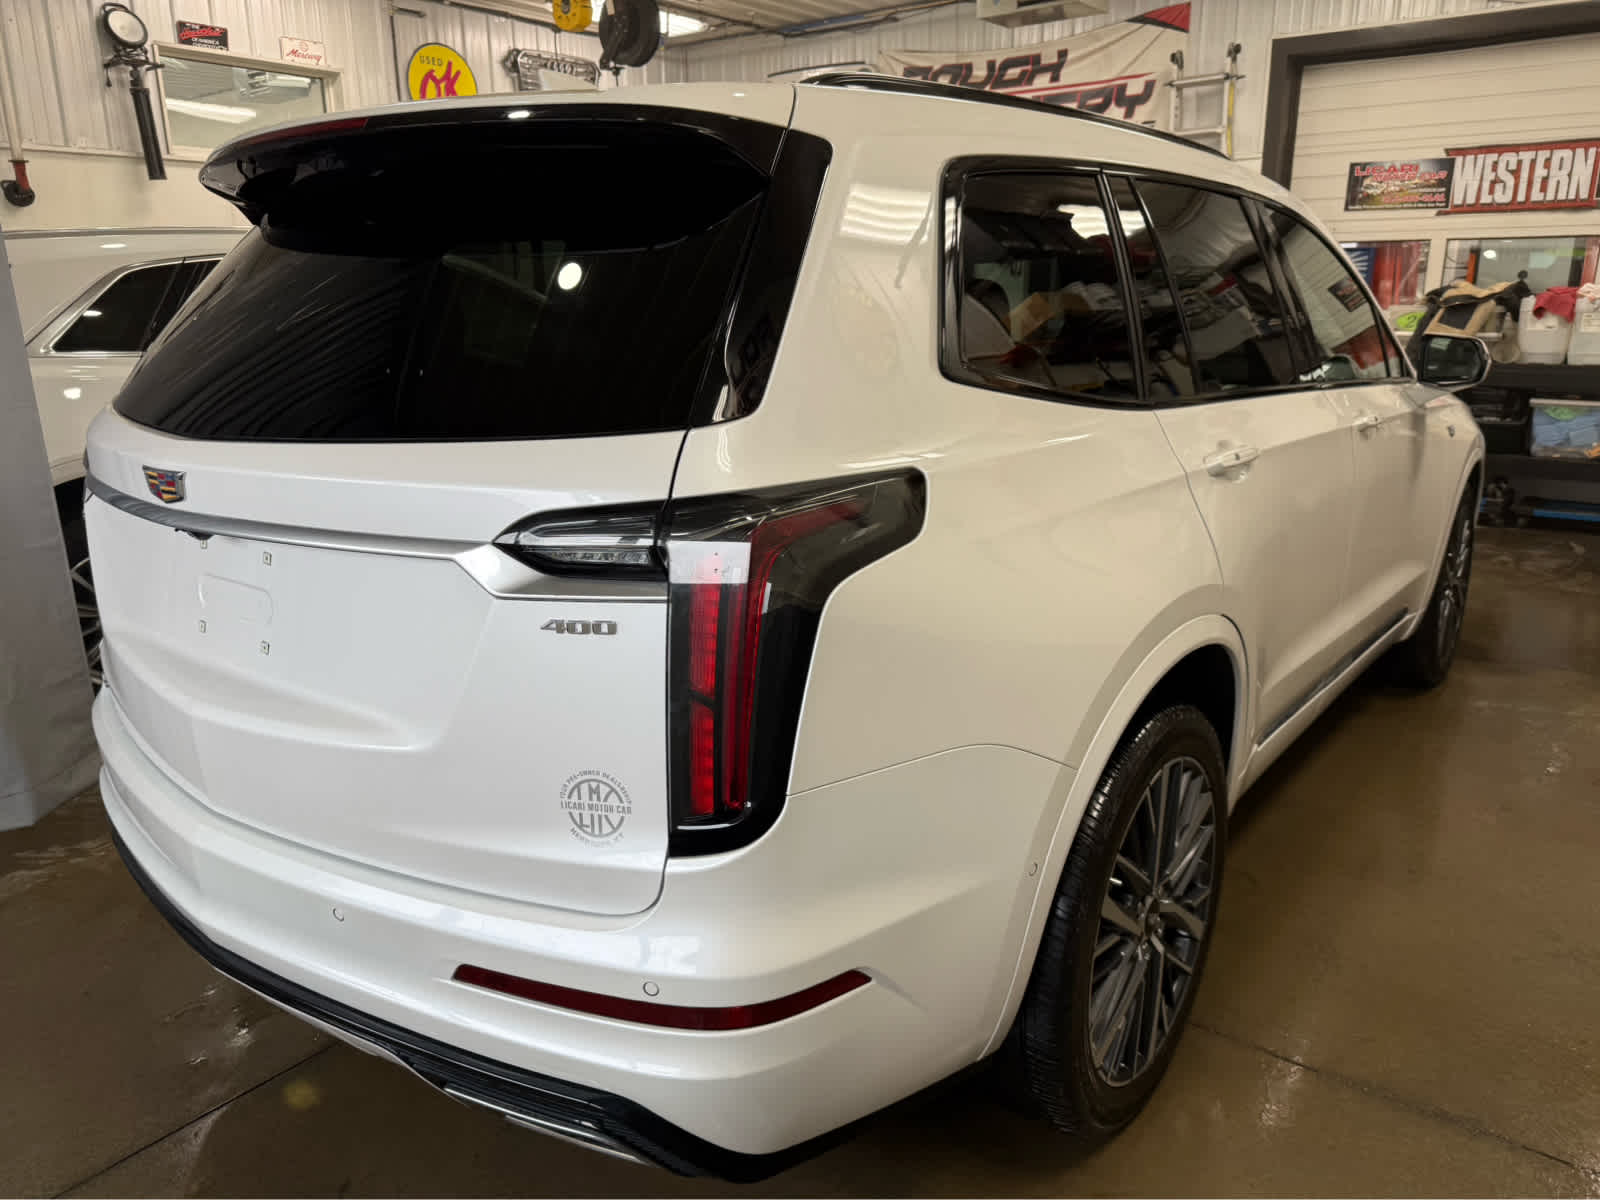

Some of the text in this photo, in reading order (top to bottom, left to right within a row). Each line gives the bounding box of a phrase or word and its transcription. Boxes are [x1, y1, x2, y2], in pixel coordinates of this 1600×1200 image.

[419, 55, 443, 66] USED
[420, 60, 461, 99] OK
[1354, 164, 1419, 177] LICARI
[1452, 147, 1597, 205] WESTERN
[540, 619, 617, 635] 400
[560, 800, 632, 815] LICARI MOTOR CAR
